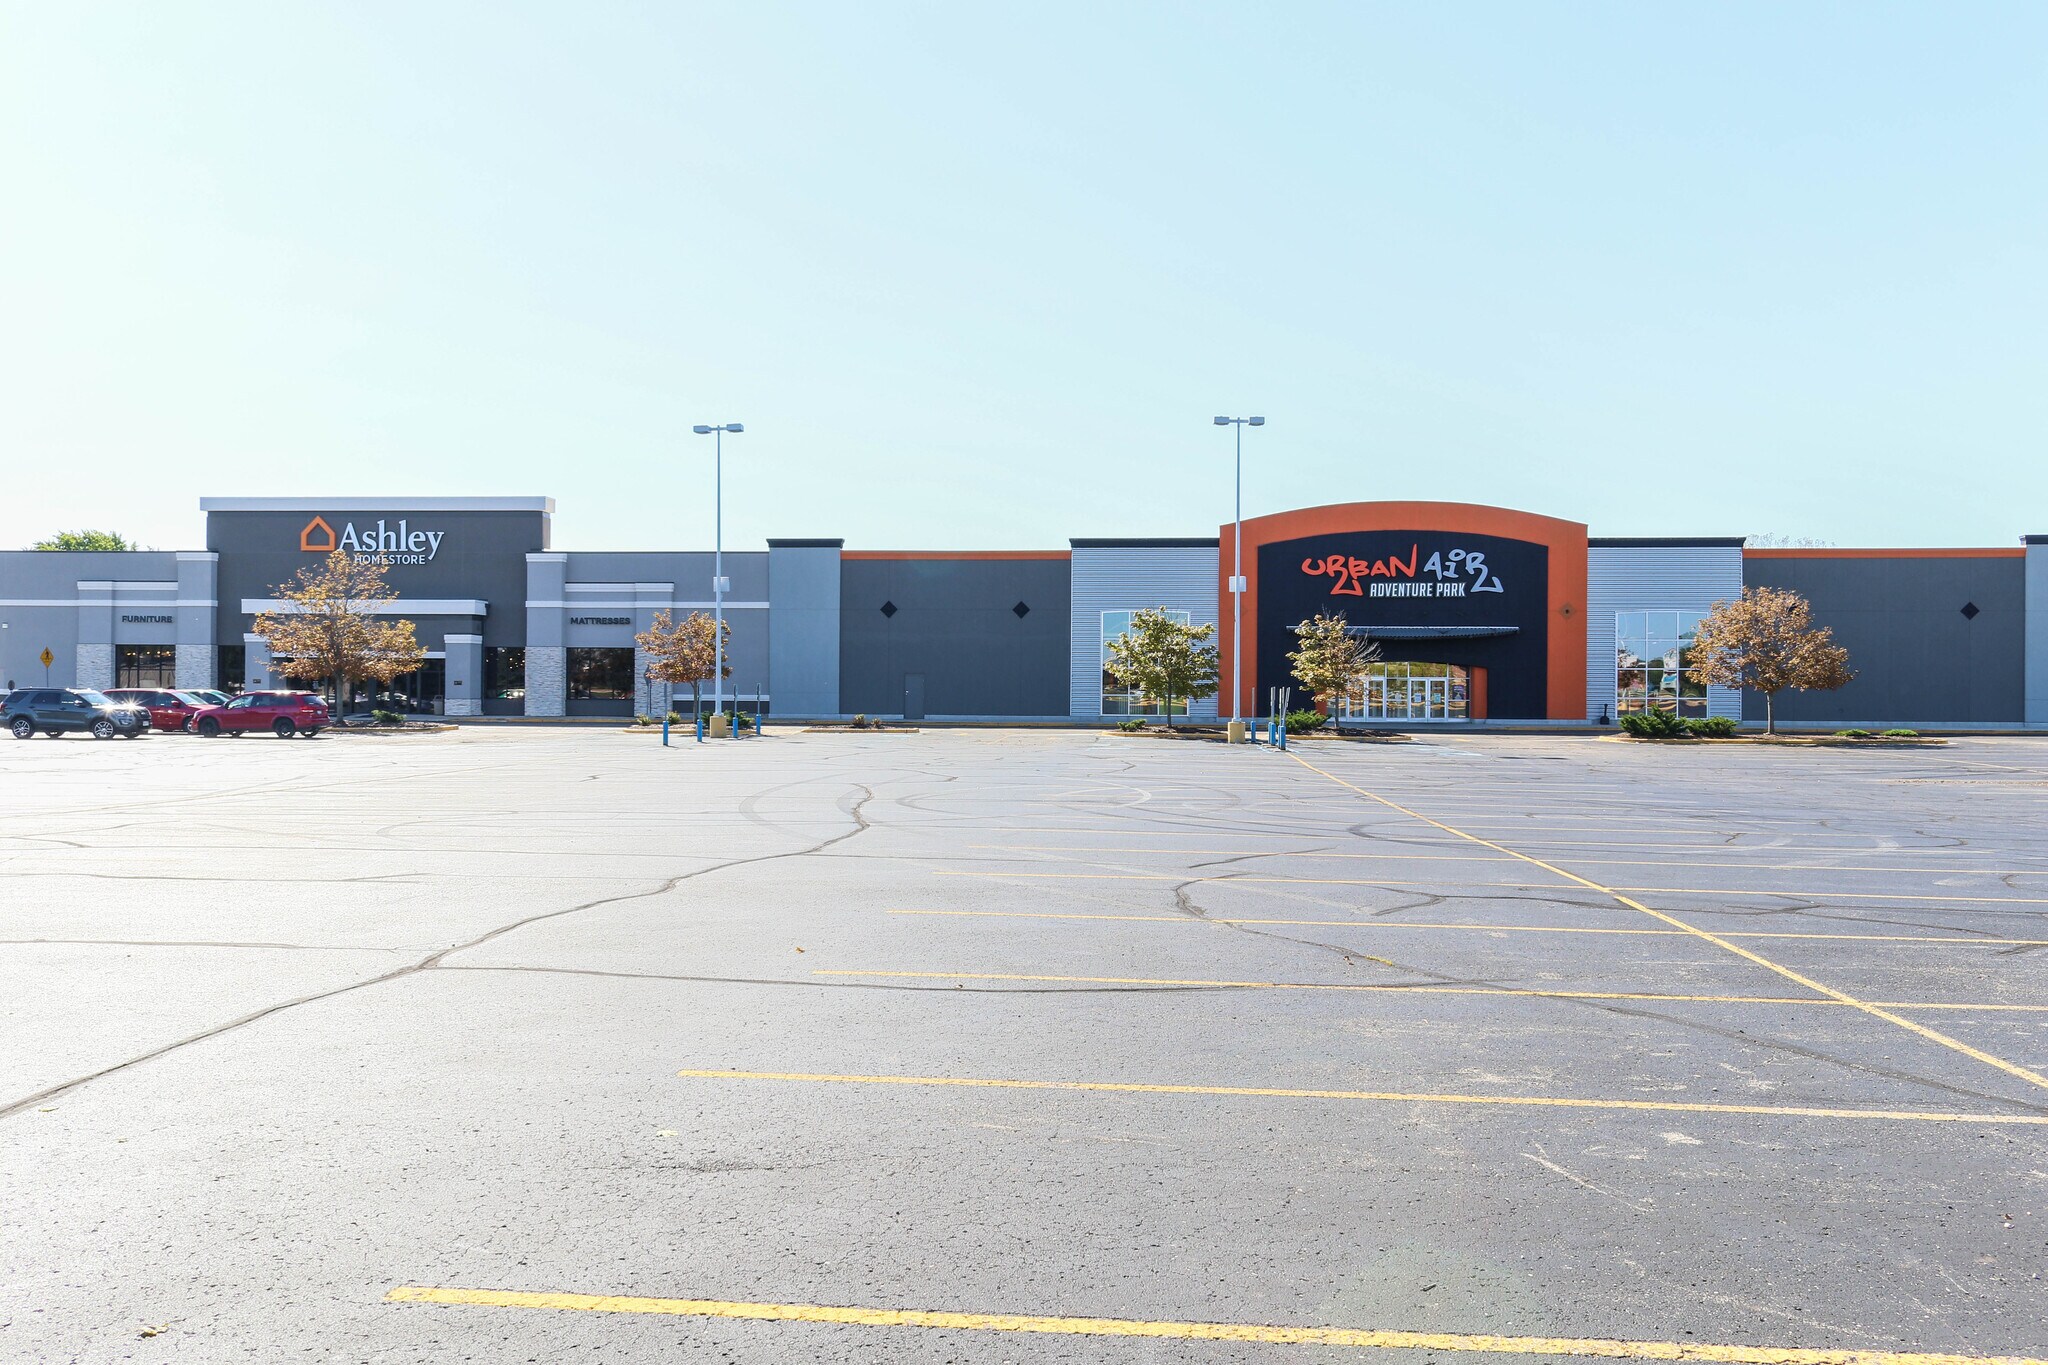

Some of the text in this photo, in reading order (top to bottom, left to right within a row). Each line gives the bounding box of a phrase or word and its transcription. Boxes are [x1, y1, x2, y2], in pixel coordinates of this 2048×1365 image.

[338, 519, 445, 561] Ashley
[354, 554, 426, 565] HOMESTORE
[1301, 543, 1418, 596] URBAN
[1369, 583, 1466, 597] ADVENTURE PARK
[121, 615, 173, 623] FURNITURE
[570, 617, 631, 625] MATTRESSES
